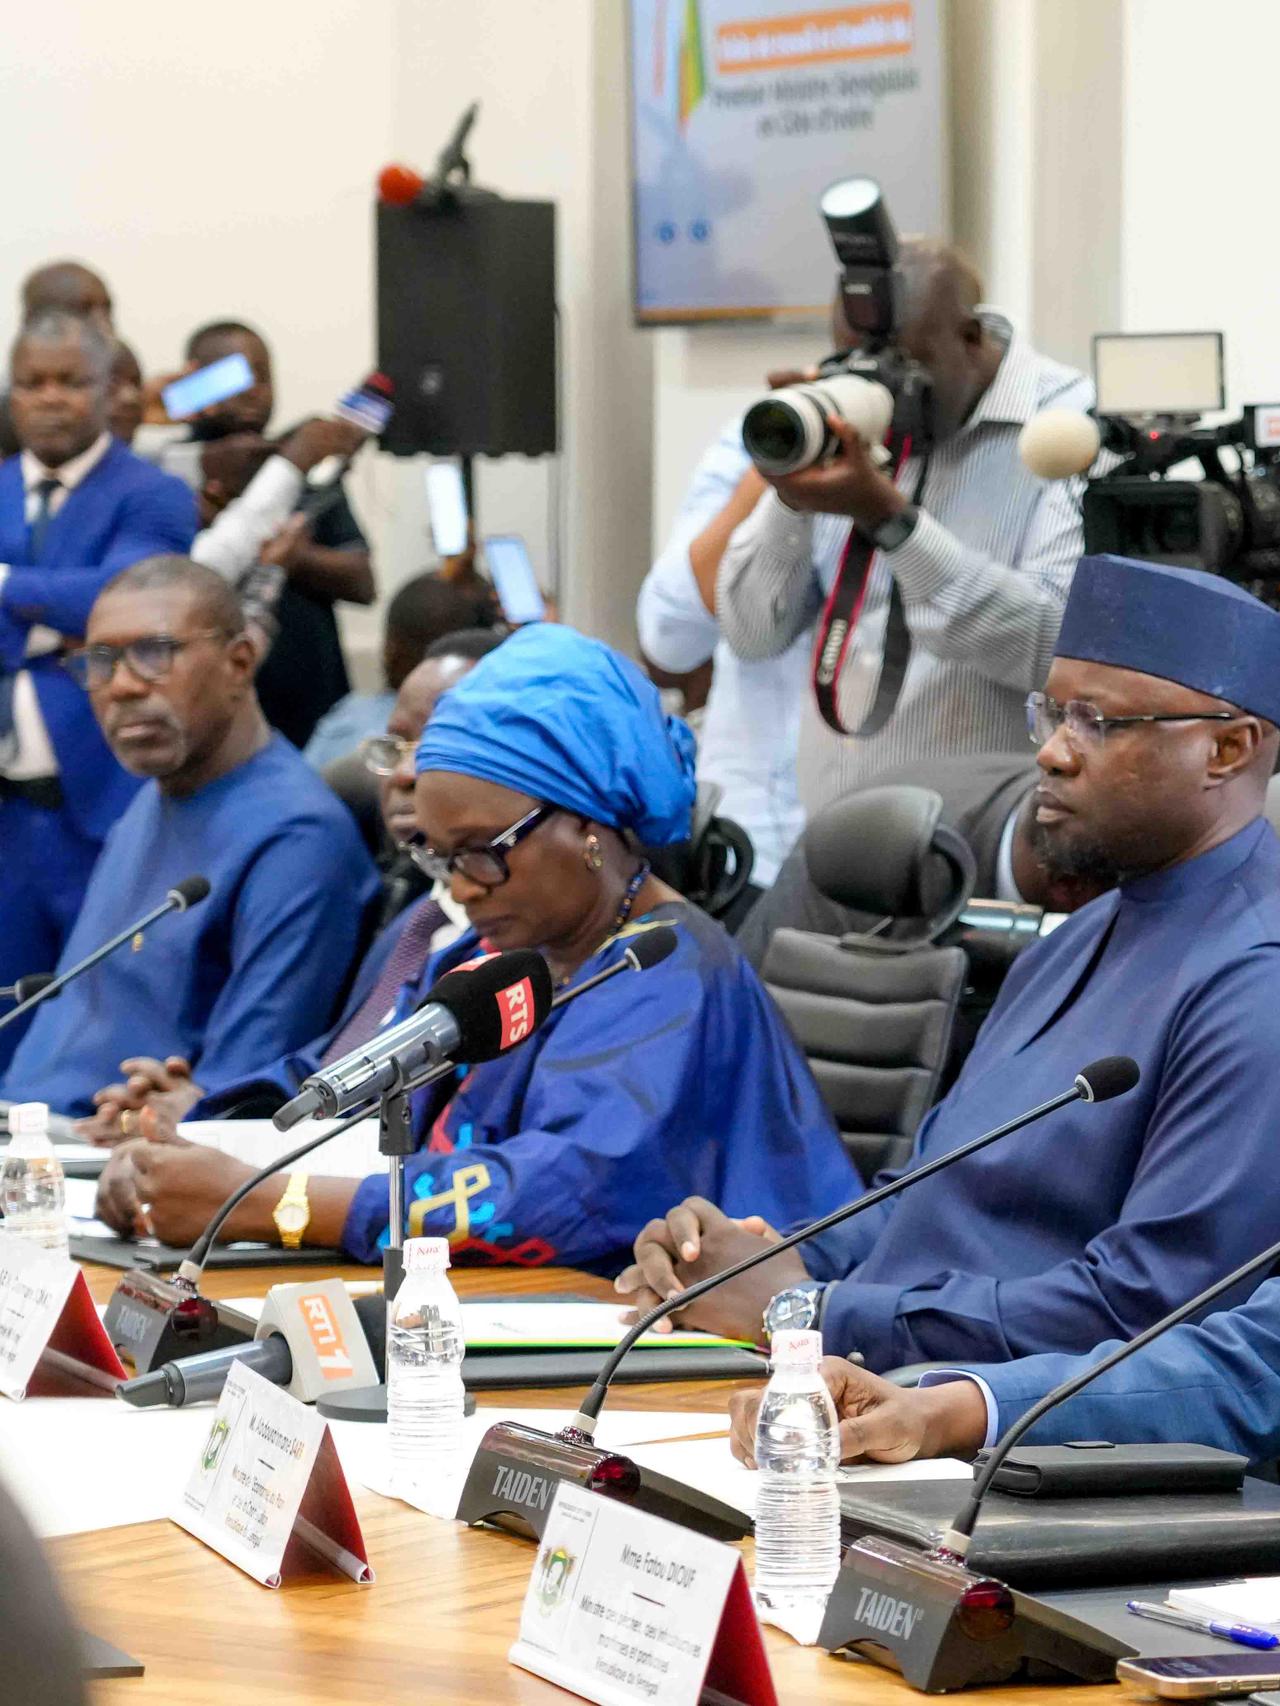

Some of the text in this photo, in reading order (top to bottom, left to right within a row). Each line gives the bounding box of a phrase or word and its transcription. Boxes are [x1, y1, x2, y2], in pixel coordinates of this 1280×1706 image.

[505, 983, 529, 1042] RTS
[492, 1465, 554, 1511] TAIDEN
[854, 1587, 922, 1641] TAIDEN
